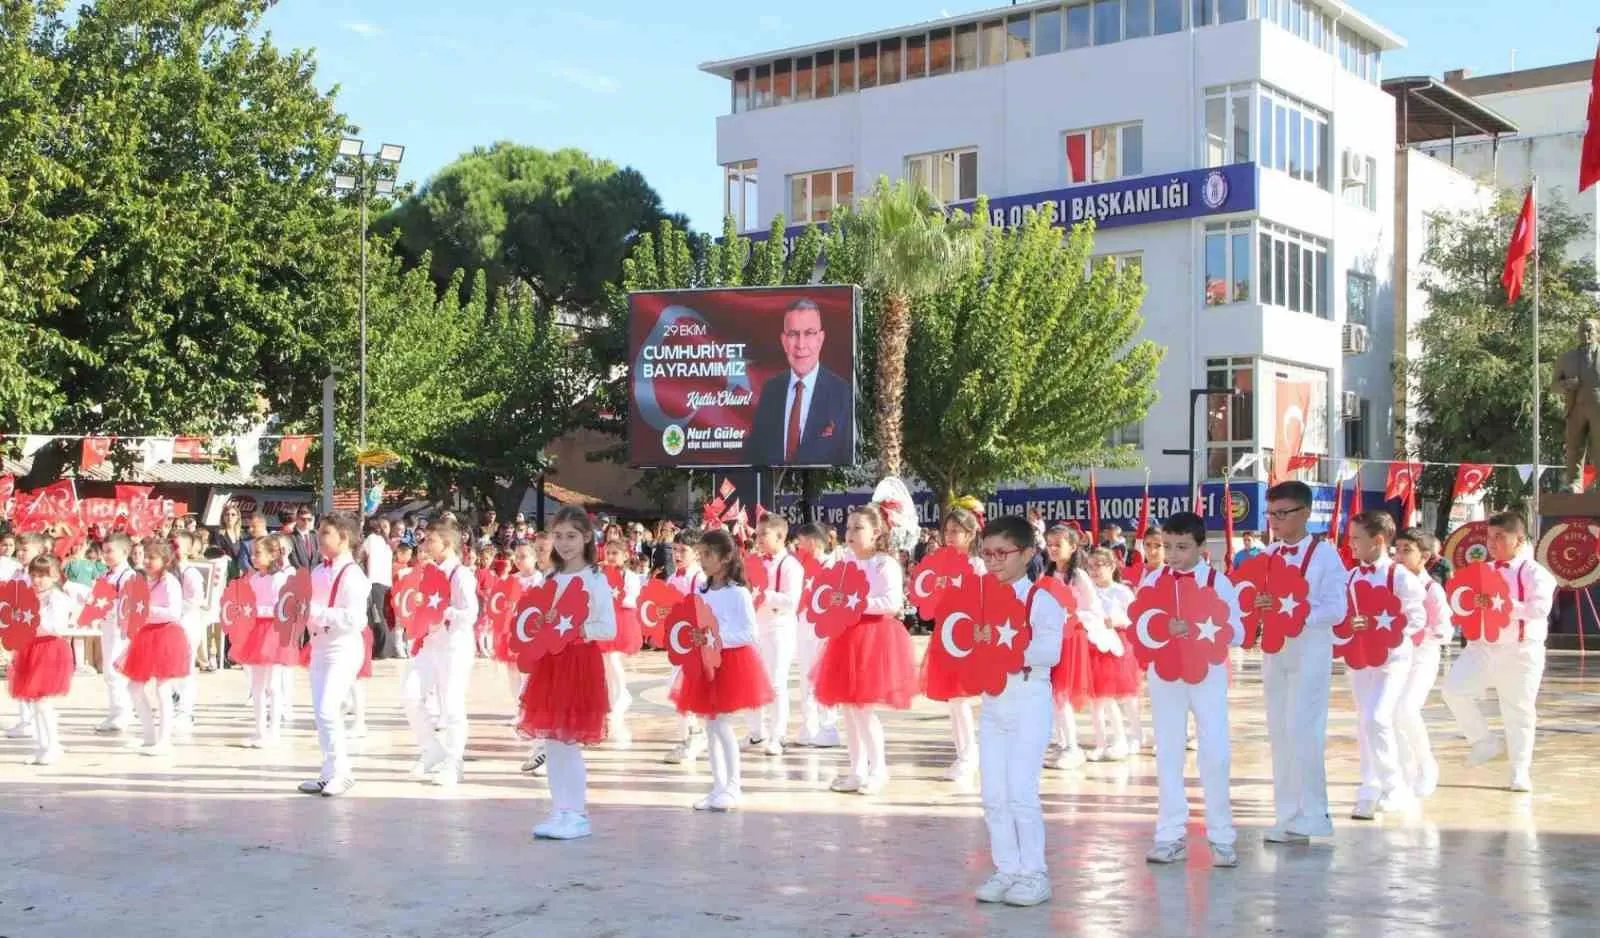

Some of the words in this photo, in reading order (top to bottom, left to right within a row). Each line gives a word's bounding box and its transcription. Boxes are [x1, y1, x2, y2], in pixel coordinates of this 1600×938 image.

[1010, 199, 1066, 228] ODSI
[1072, 179, 1189, 224] BAŞKANLIĞI
[663, 325, 679, 337] 29
[680, 323, 707, 336] EKİM
[643, 341, 747, 360] CUMHURİYET
[643, 361, 746, 378] BAYRAMIMIZ
[686, 391, 717, 409] Kutlu
[717, 390, 753, 407] Olsun!
[687, 427, 711, 440] Nuri
[714, 426, 746, 440] Güler
[828, 507, 844, 523] ve
